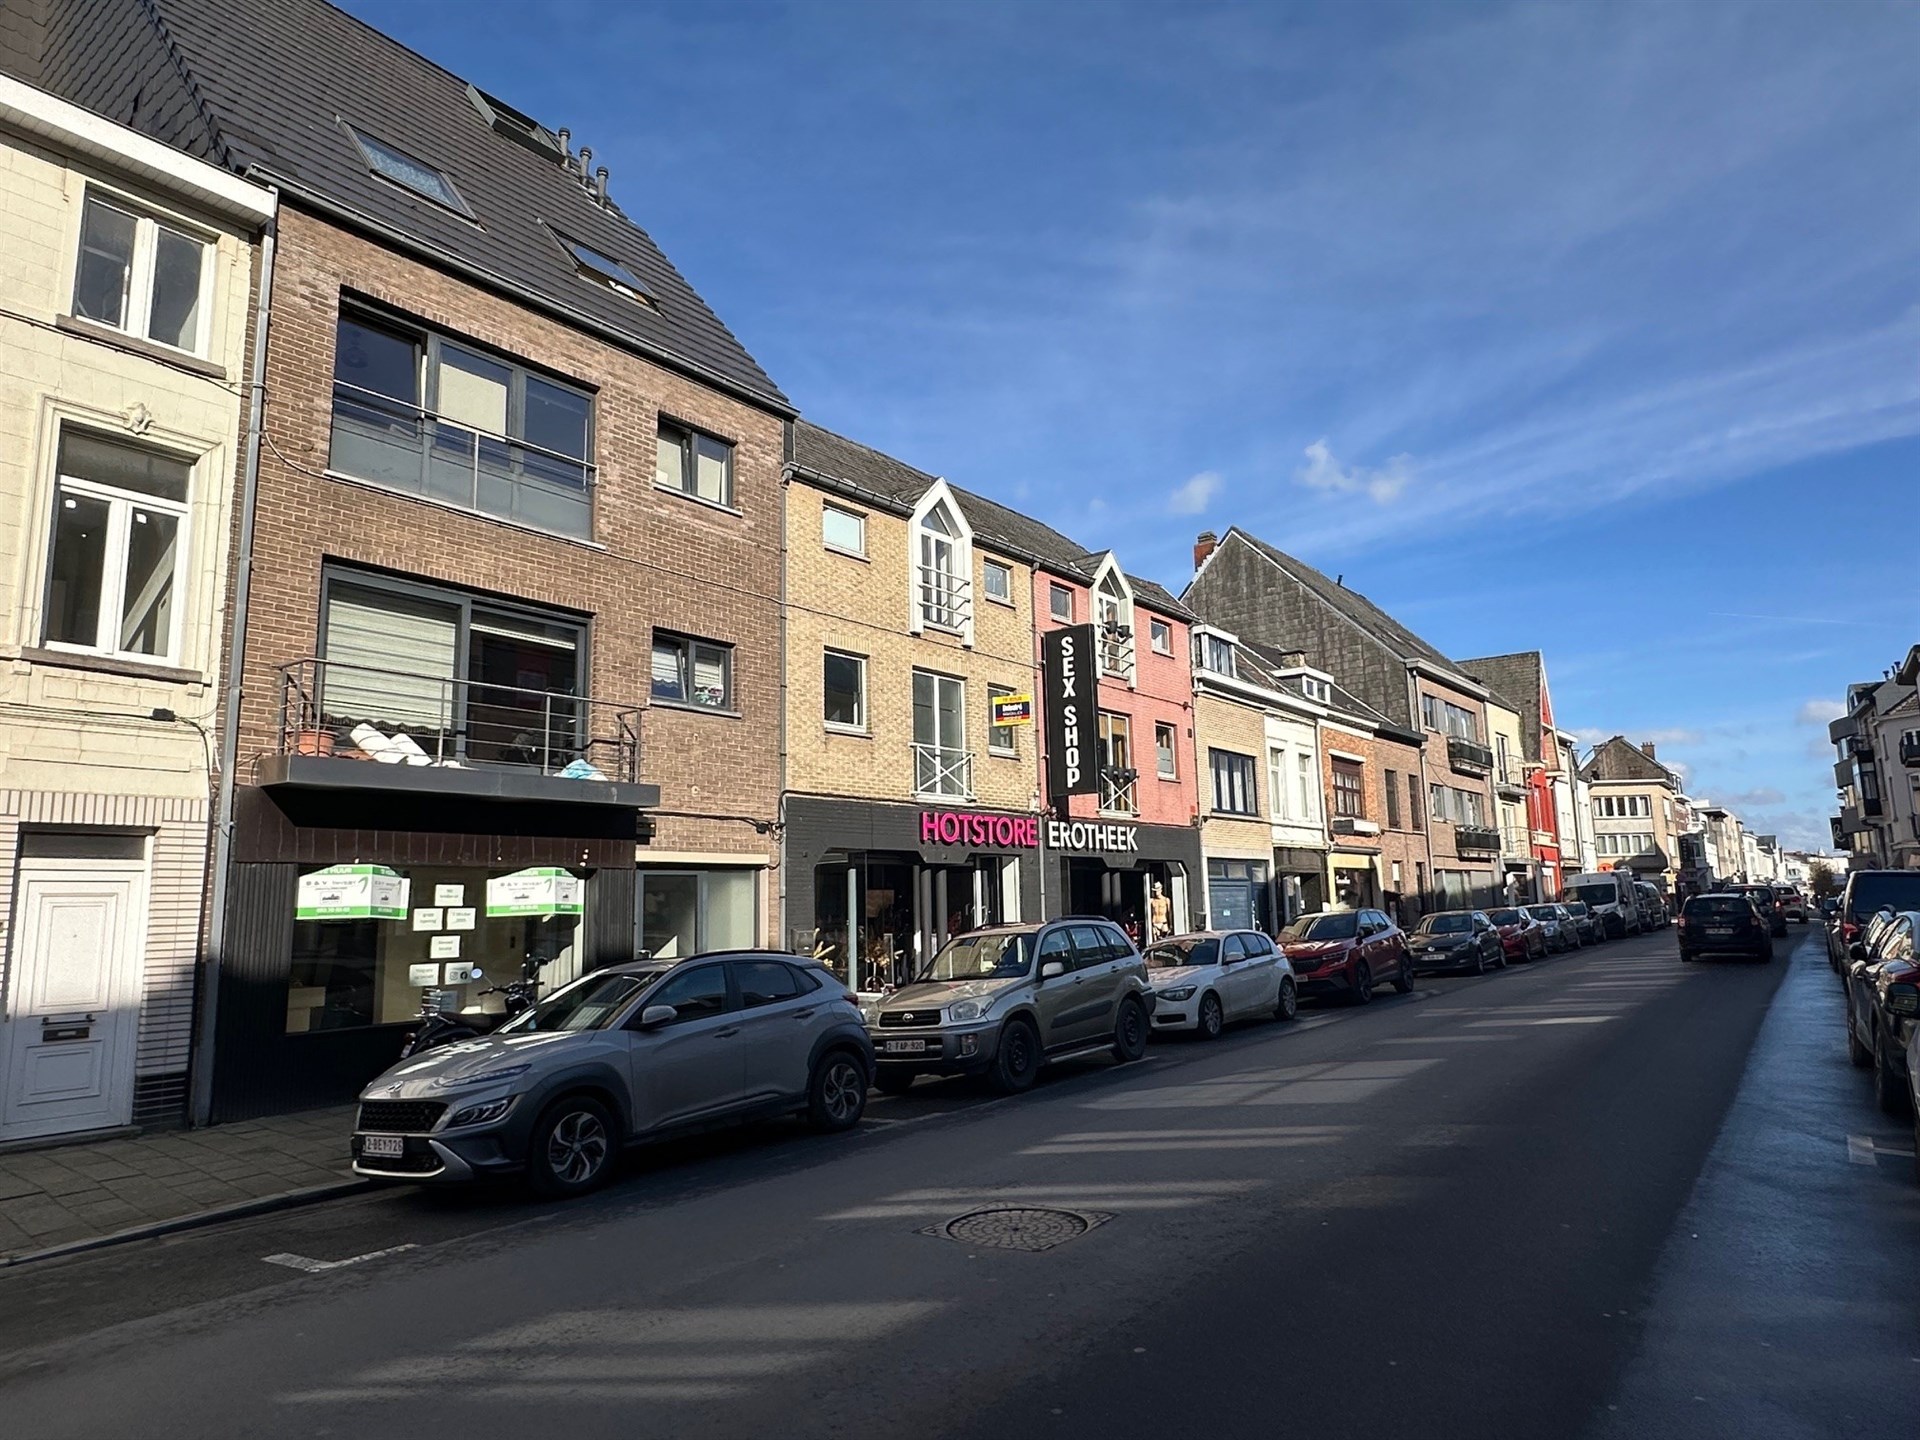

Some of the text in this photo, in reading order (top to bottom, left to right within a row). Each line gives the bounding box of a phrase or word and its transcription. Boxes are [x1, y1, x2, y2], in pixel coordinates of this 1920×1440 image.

[1060, 636, 1080, 788] SEX SHOP
[921, 811, 1138, 850] HOTSTORE EROTHEEK
